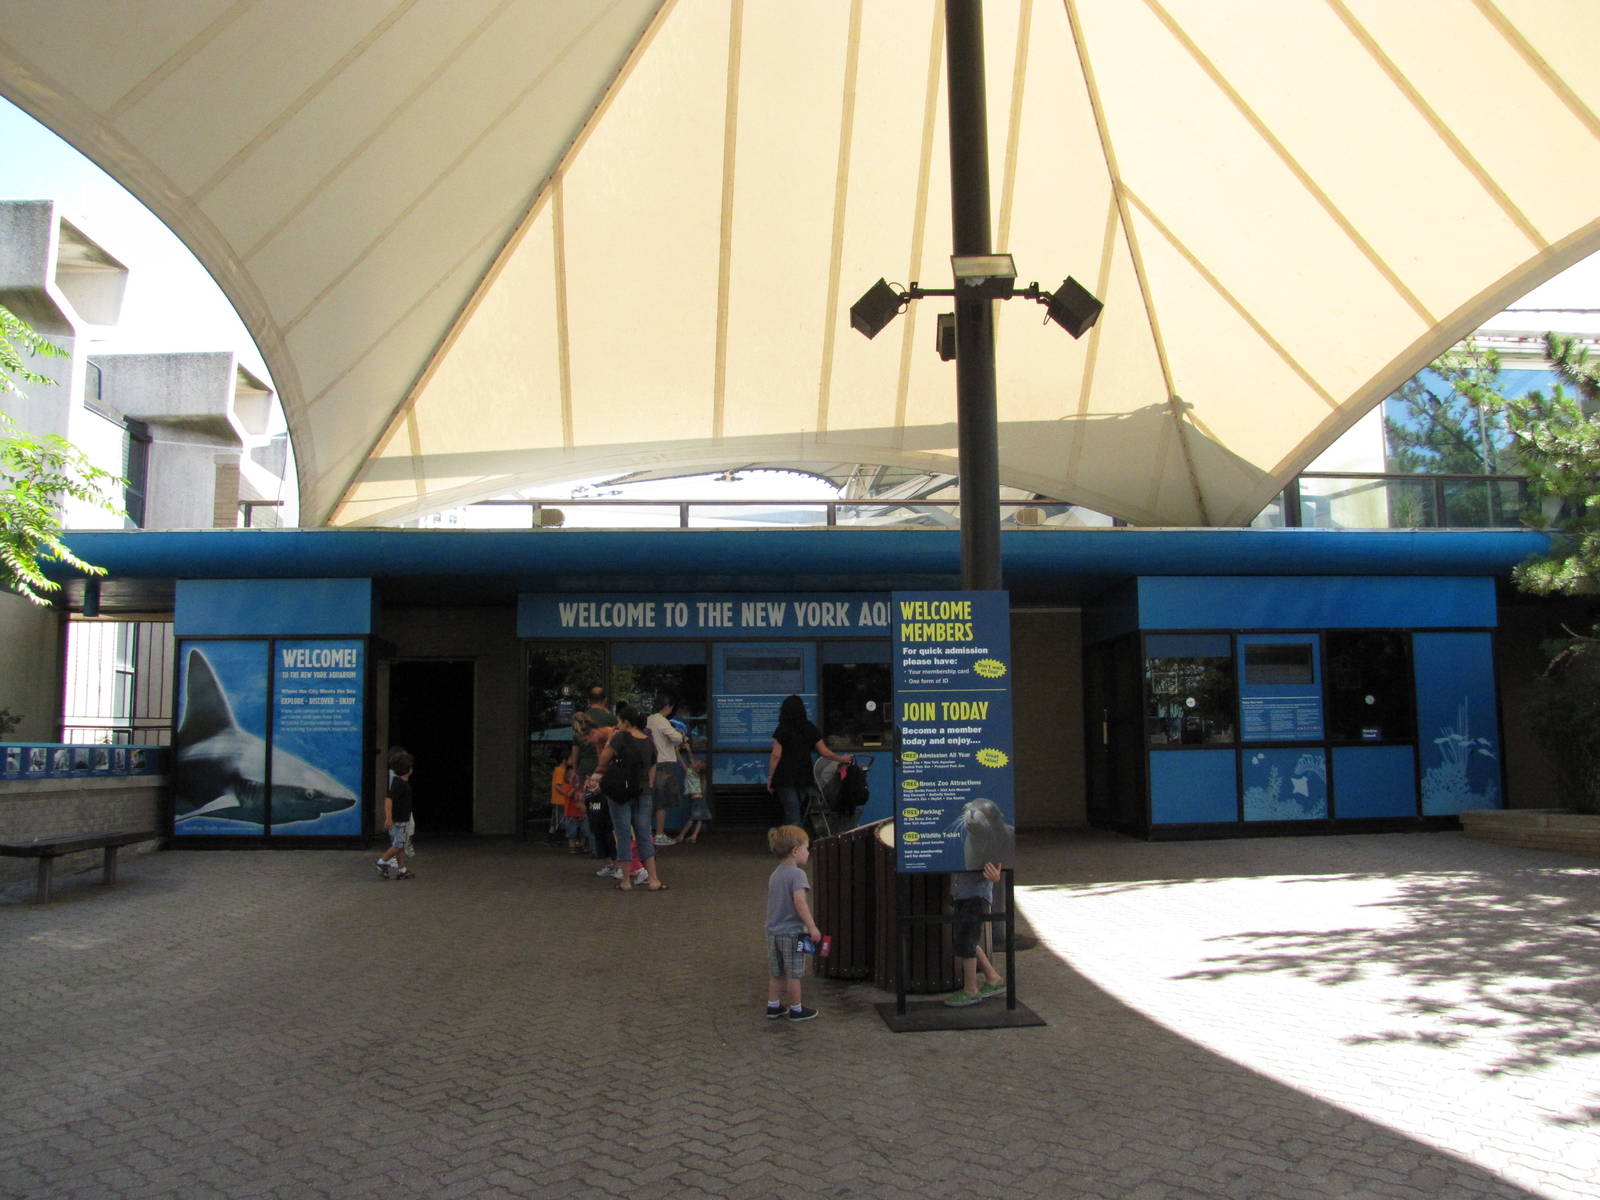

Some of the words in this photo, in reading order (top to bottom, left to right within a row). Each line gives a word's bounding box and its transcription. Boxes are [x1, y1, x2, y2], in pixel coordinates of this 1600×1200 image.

[558, 602, 656, 628] WELCOME
[664, 602, 688, 628] TO
[696, 602, 734, 628] THE
[741, 602, 786, 627] NEW
[794, 602, 850, 627] YORK
[900, 601, 972, 620] WELCOME
[901, 623, 974, 642] MEMBERS
[283, 649, 357, 668] WELCOME!
[902, 647, 917, 655] For
[919, 647, 943, 657] quick
[944, 646, 989, 655] admission
[902, 658, 932, 667] please
[933, 657, 958, 665] have:
[922, 668, 957, 676] membership
[902, 702, 936, 722] JOIN
[941, 701, 988, 720] TODAY
[902, 727, 937, 735] Become
[947, 726, 982, 734] member
[902, 738, 927, 746] today
[947, 736, 981, 746] enjoy....
